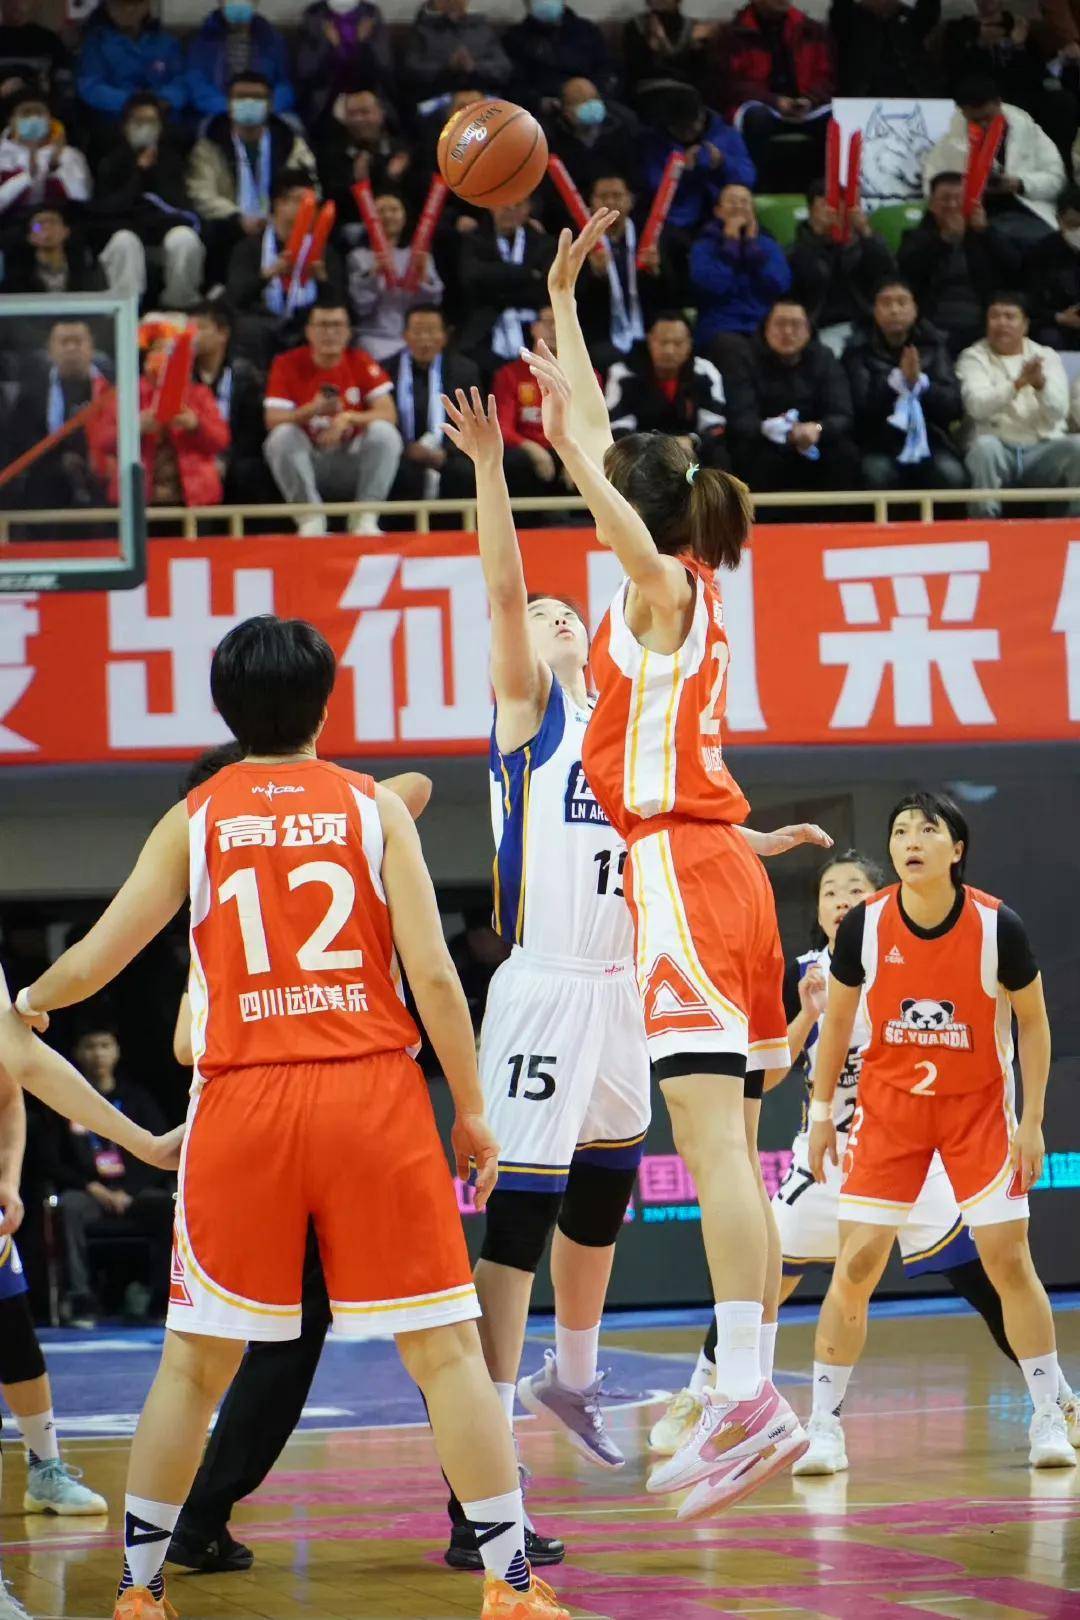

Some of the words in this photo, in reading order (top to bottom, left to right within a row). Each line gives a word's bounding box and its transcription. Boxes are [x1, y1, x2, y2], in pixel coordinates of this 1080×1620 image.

[571, 803, 586, 819] LN
[215, 813, 348, 853] 高颂
[218, 861, 364, 975] 12
[239, 983, 369, 1022] 四川远达美乐
[885, 1027, 970, 1049] SC.YUANDA
[507, 1053, 557, 1101] 15
[910, 1060, 938, 1096] 2
